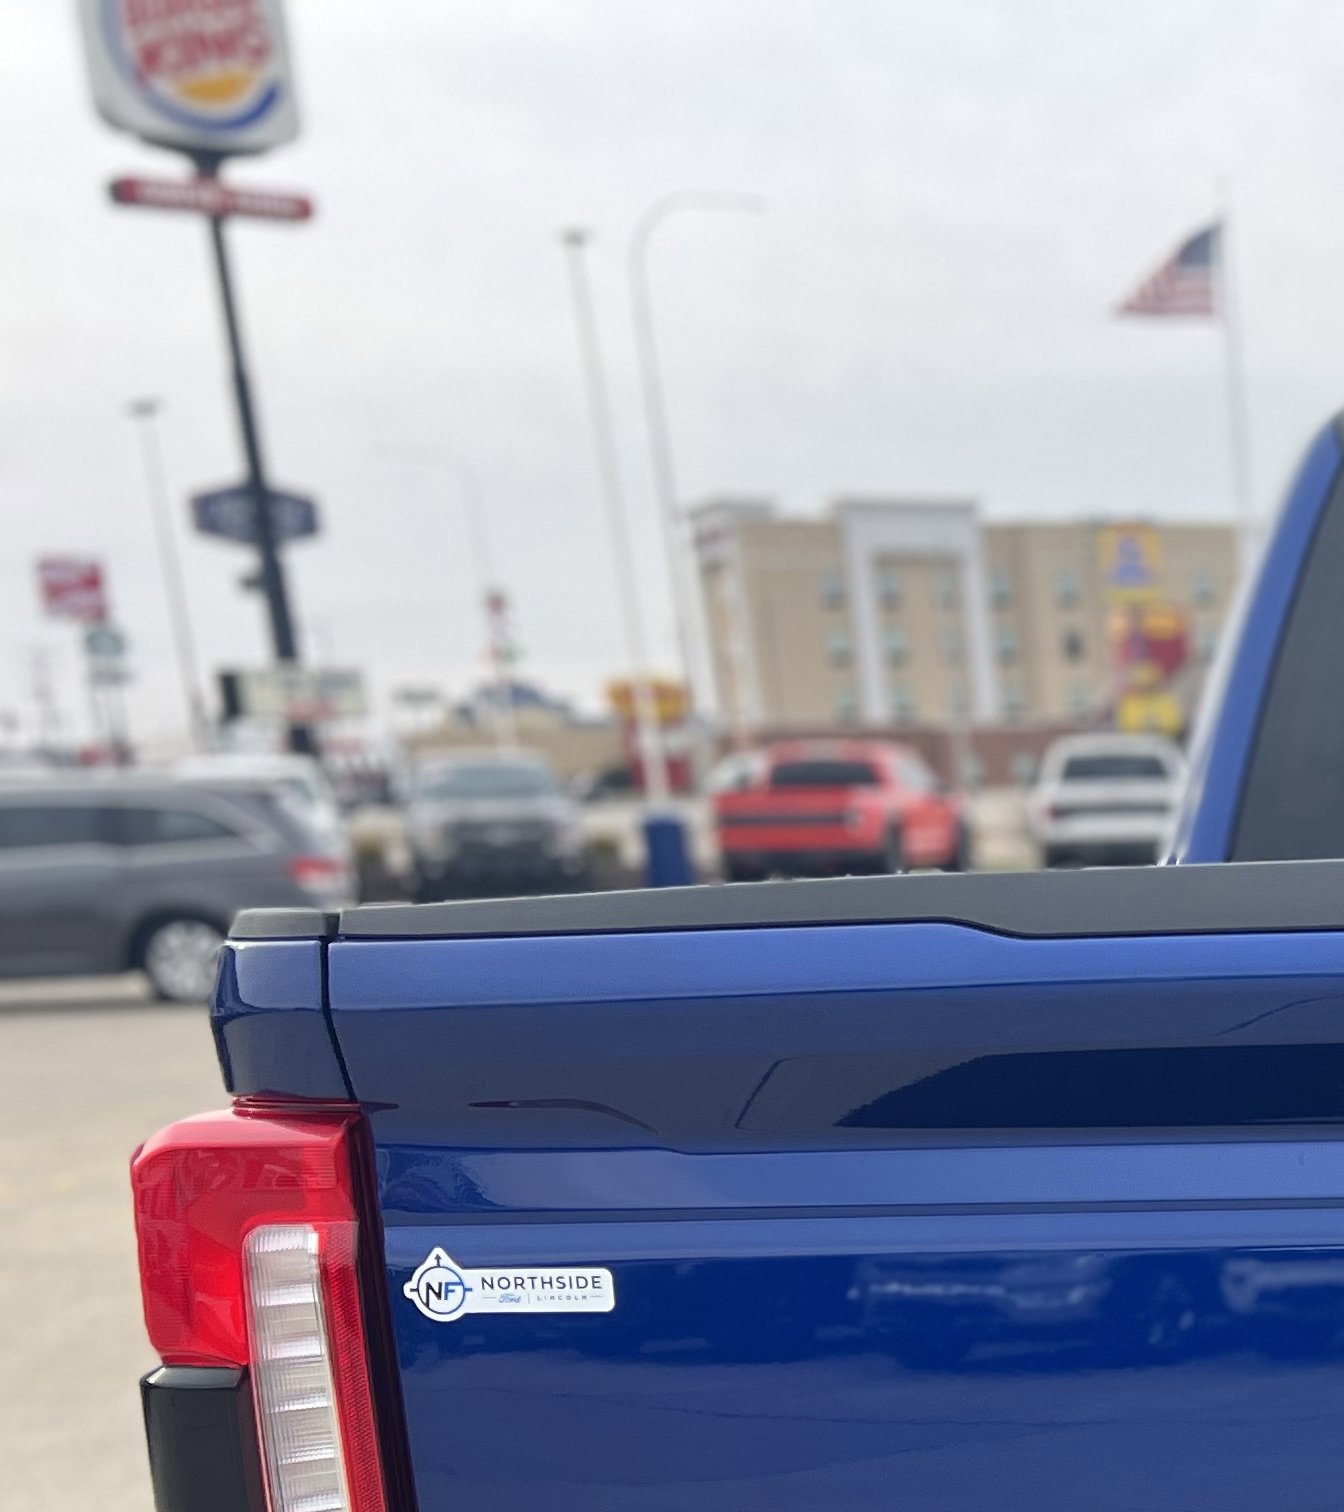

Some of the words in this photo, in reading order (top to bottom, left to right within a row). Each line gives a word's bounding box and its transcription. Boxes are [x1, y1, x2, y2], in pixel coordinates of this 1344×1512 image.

[481, 1275, 603, 1291] NORTHSIDE
[425, 1281, 464, 1308] NF
[498, 1293, 522, 1304] Ford
